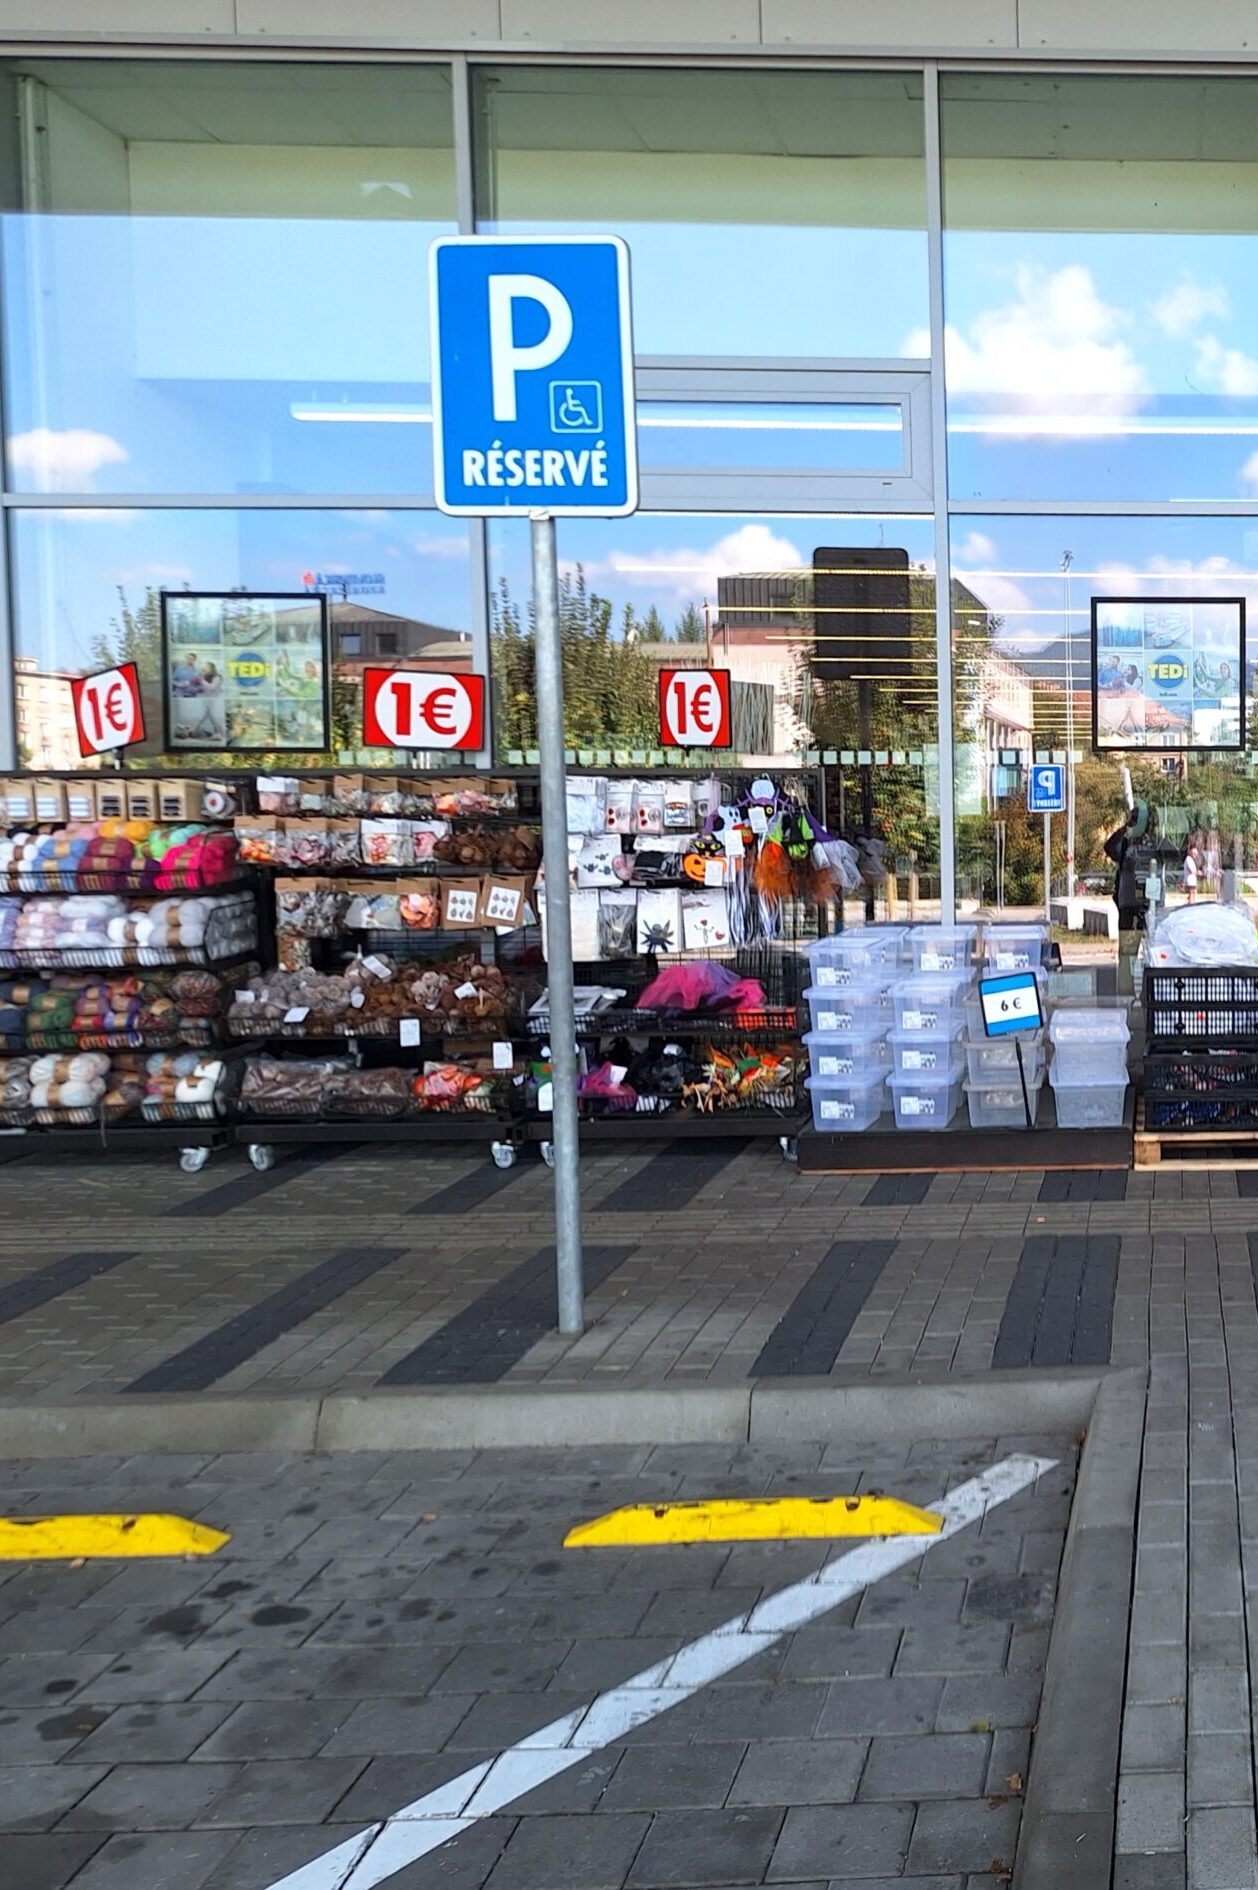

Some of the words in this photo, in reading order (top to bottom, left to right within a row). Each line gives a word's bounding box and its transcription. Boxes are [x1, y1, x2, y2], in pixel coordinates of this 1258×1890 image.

[488, 274, 573, 421] P
[462, 439, 608, 487] RÉSERVÉ
[227, 660, 272, 679] TEDi
[1146, 663, 1189, 680] TEDi
